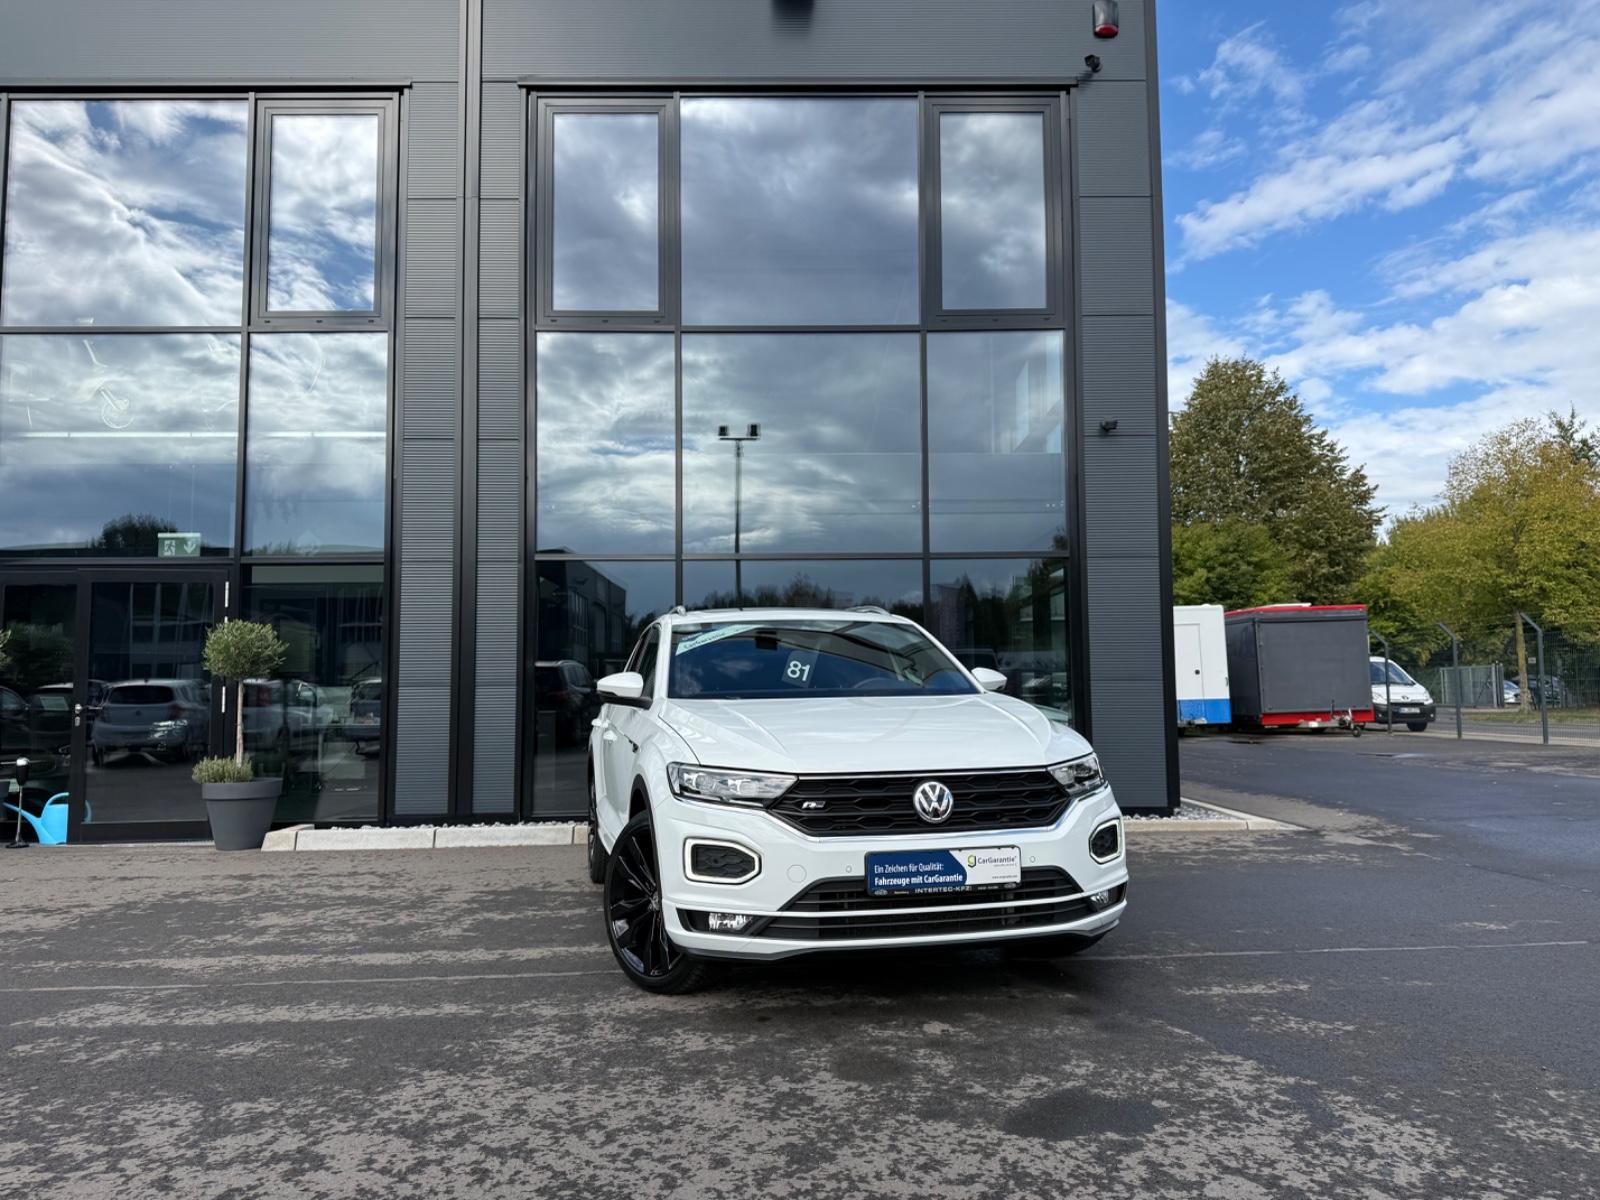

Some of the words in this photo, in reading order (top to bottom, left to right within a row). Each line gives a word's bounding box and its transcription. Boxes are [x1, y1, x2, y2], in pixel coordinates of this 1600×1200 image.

[787, 660, 811, 681] 81
[874, 864, 884, 874] Ein
[884, 863, 908, 874] Zeichen
[908, 862, 918, 873] für
[918, 862, 944, 873] Qualität:
[874, 875, 910, 887] Fahrzeuge
[910, 875, 923, 884] mit
[923, 873, 964, 884] CarGarantie
